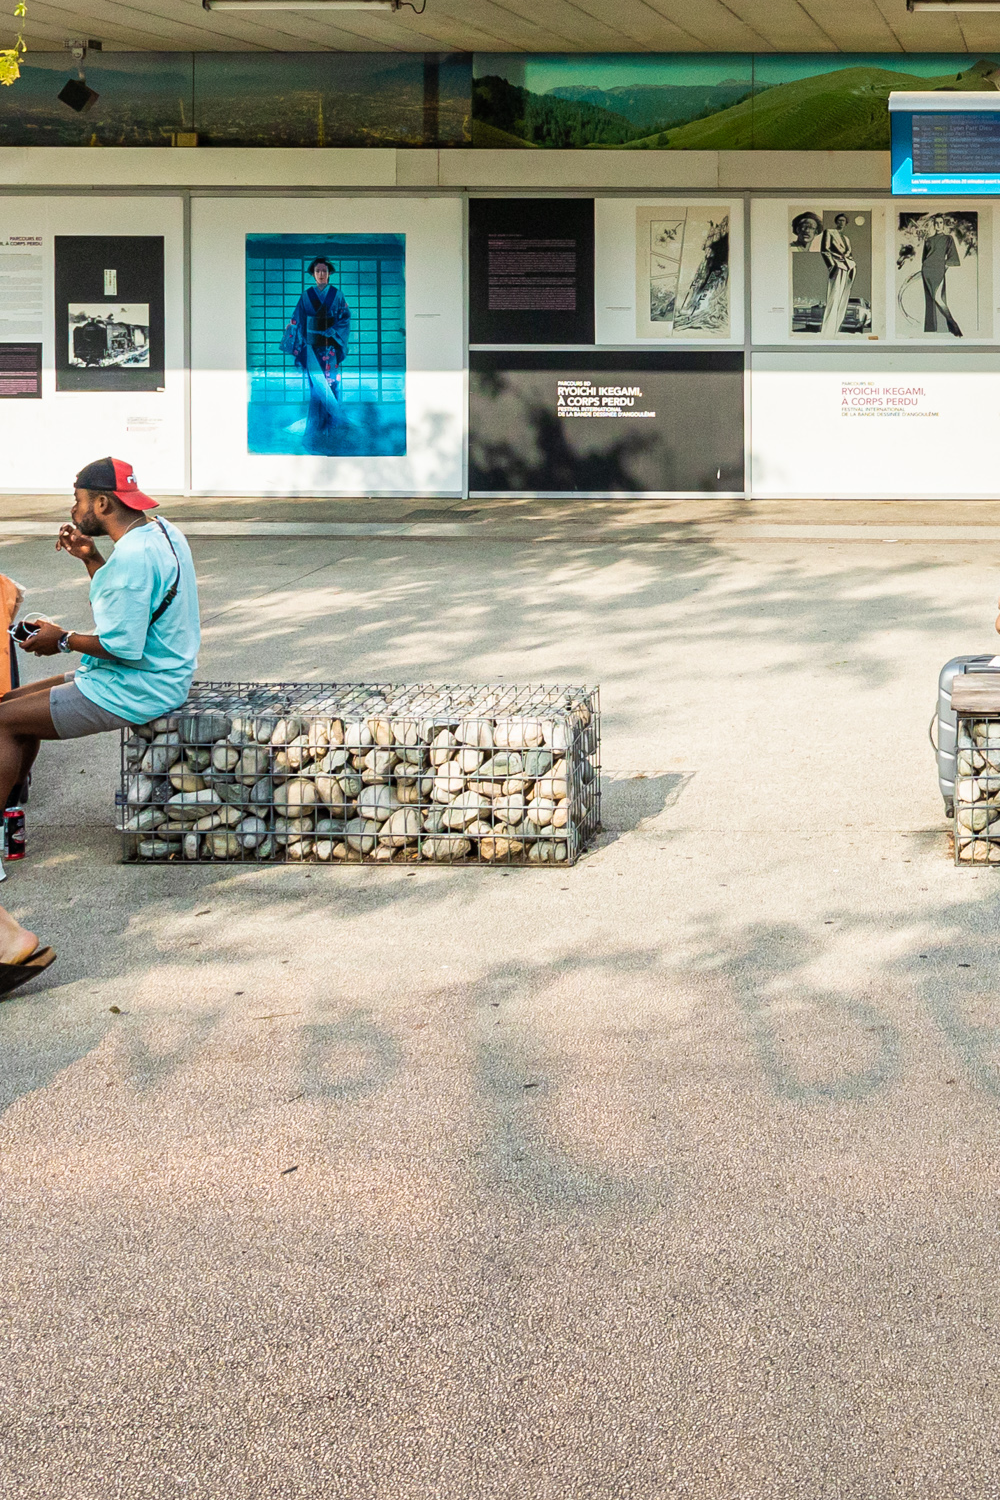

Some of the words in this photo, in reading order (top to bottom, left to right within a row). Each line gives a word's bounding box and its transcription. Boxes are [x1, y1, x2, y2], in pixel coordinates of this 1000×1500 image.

[557, 387, 596, 395] RYOICHI
[599, 387, 643, 397] IKEGAMI,
[883, 388, 926, 396] IKEGAMI,
[557, 396, 565, 406] À
[567, 397, 600, 406] CORPS
[602, 397, 635, 406] PERDU
[841, 396, 848, 405] À
[851, 398, 883, 406] CORPS
[886, 398, 918, 406] PERDU
